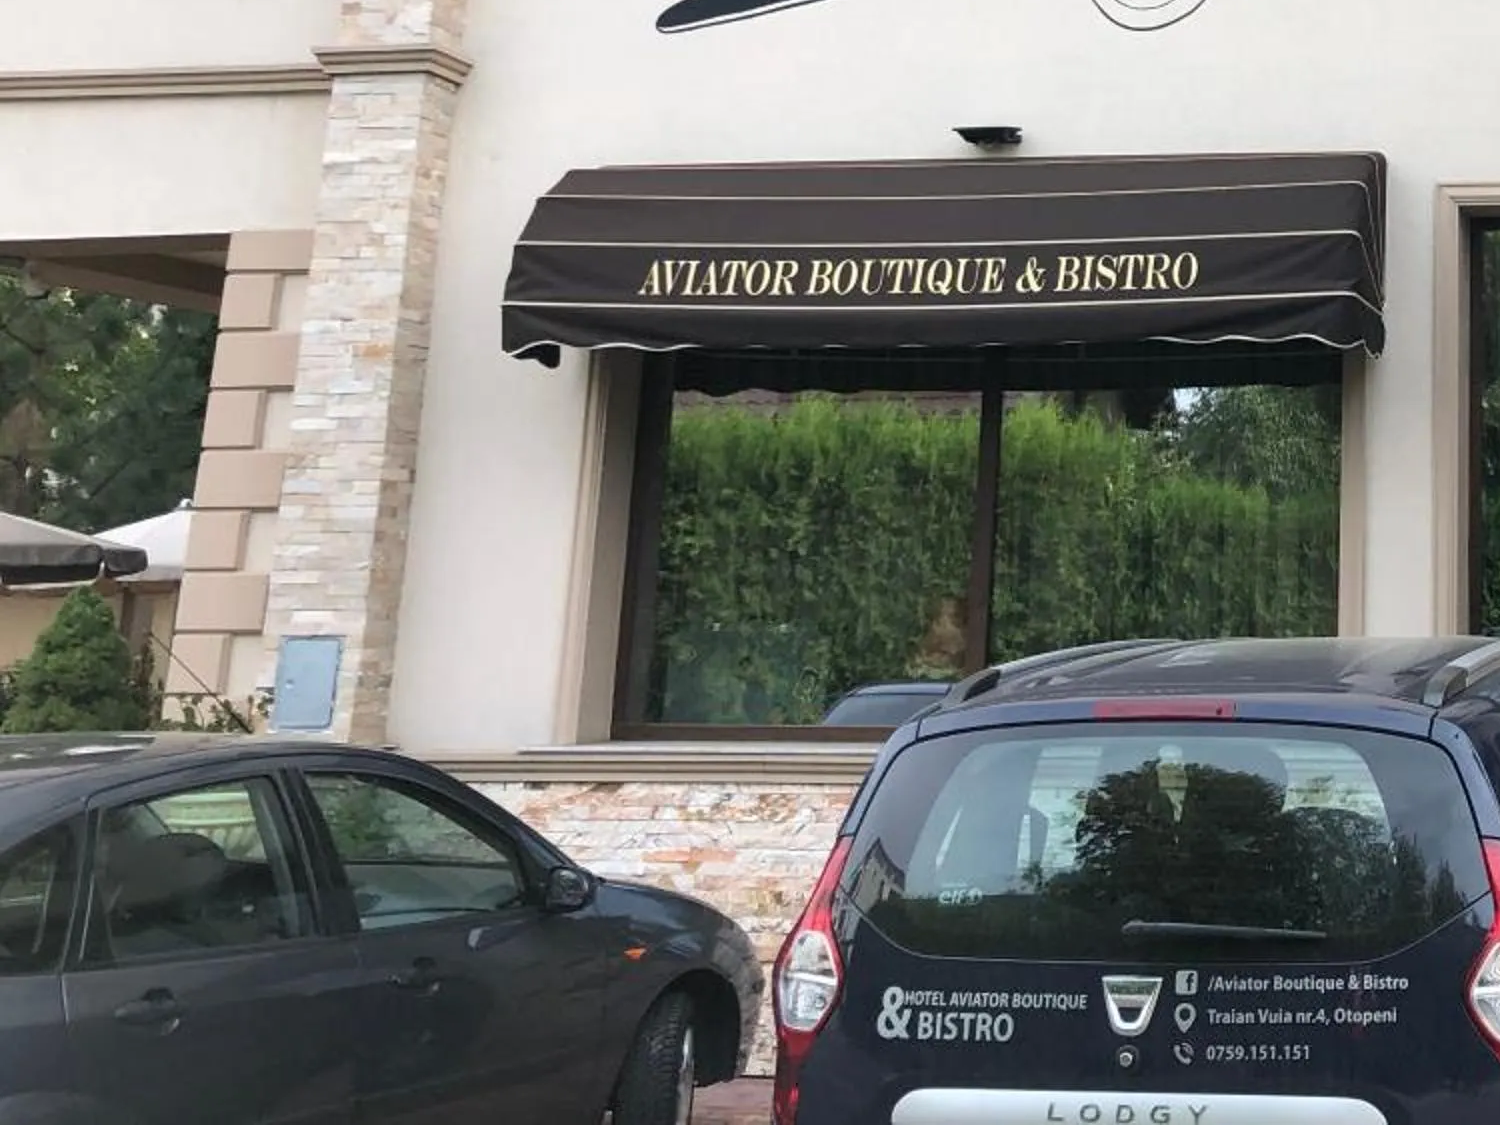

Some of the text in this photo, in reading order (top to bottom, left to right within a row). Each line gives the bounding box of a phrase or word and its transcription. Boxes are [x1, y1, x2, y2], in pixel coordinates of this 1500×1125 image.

[637, 251, 1199, 297] AVIATOR BOUTIQUE & BISTRO
[1272, 974, 1345, 994] Boutique
[1347, 974, 1361, 991] &
[1363, 974, 1410, 991] Bistro
[904, 989, 1089, 1011] HOTEL AVIATOR BOUTIQUE
[876, 985, 1014, 1042] & BISTRO
[1207, 1007, 1255, 1025] Traian
[1257, 1007, 1293, 1024] Vuia
[1333, 1006, 1397, 1027] Otopeni
[1205, 1044, 1310, 1061] 0759.151.151
[1047, 1101, 1208, 1125] LODGY
